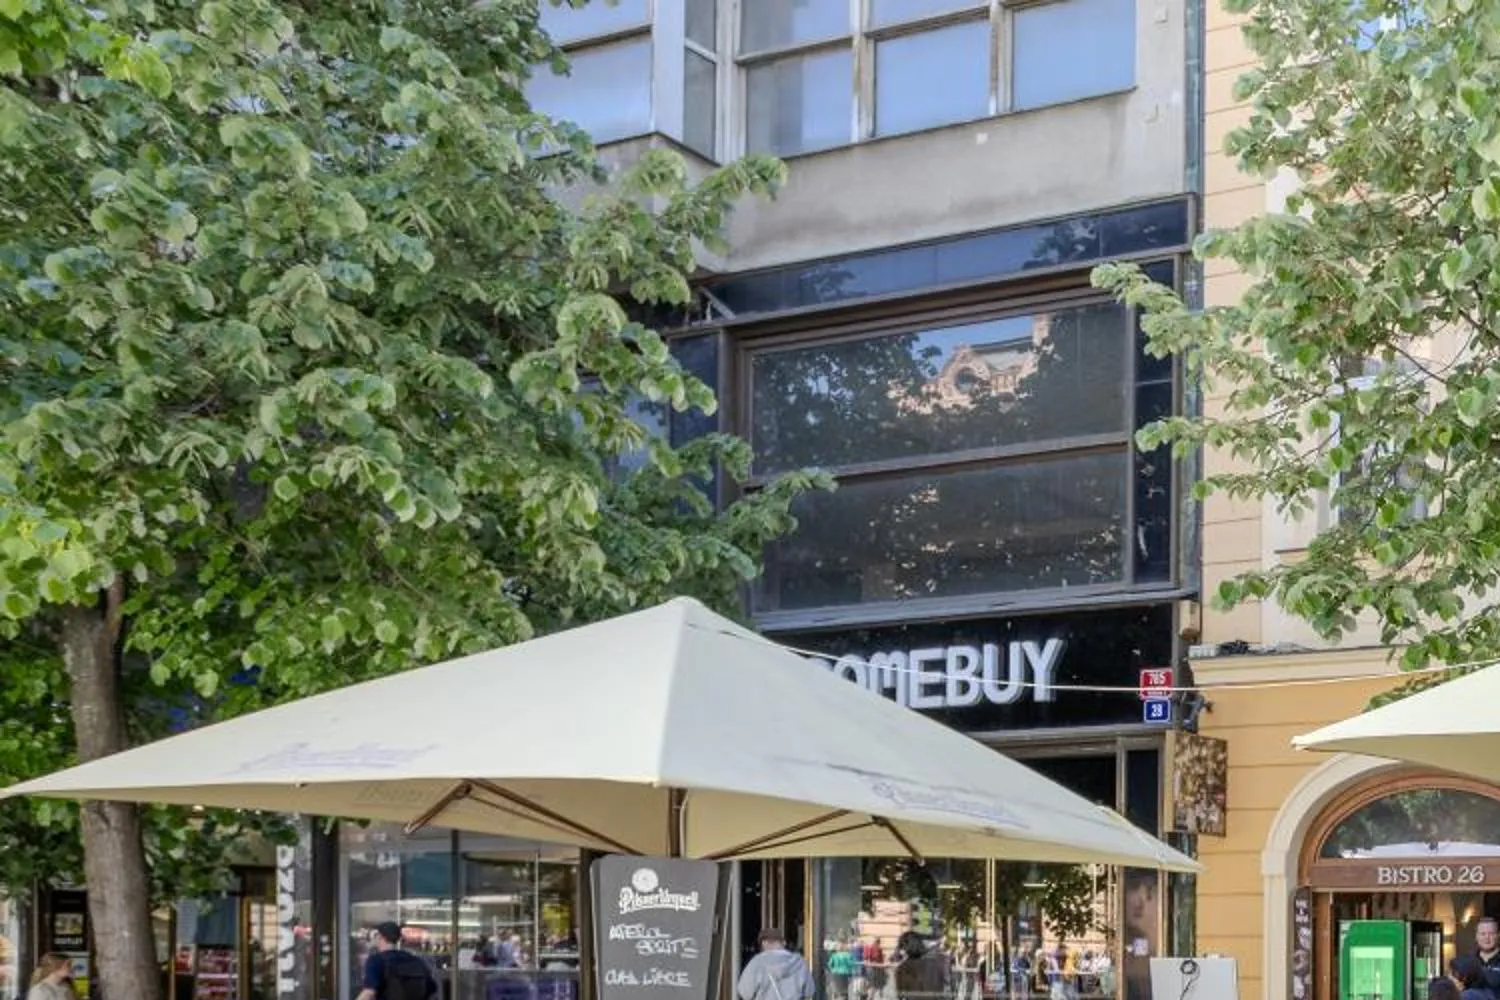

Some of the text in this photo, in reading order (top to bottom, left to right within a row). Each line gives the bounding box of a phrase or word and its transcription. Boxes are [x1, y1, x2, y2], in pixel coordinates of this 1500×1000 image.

[806, 637, 1062, 709] OMEBUY
[1377, 865, 1485, 885] BISTRO 26
